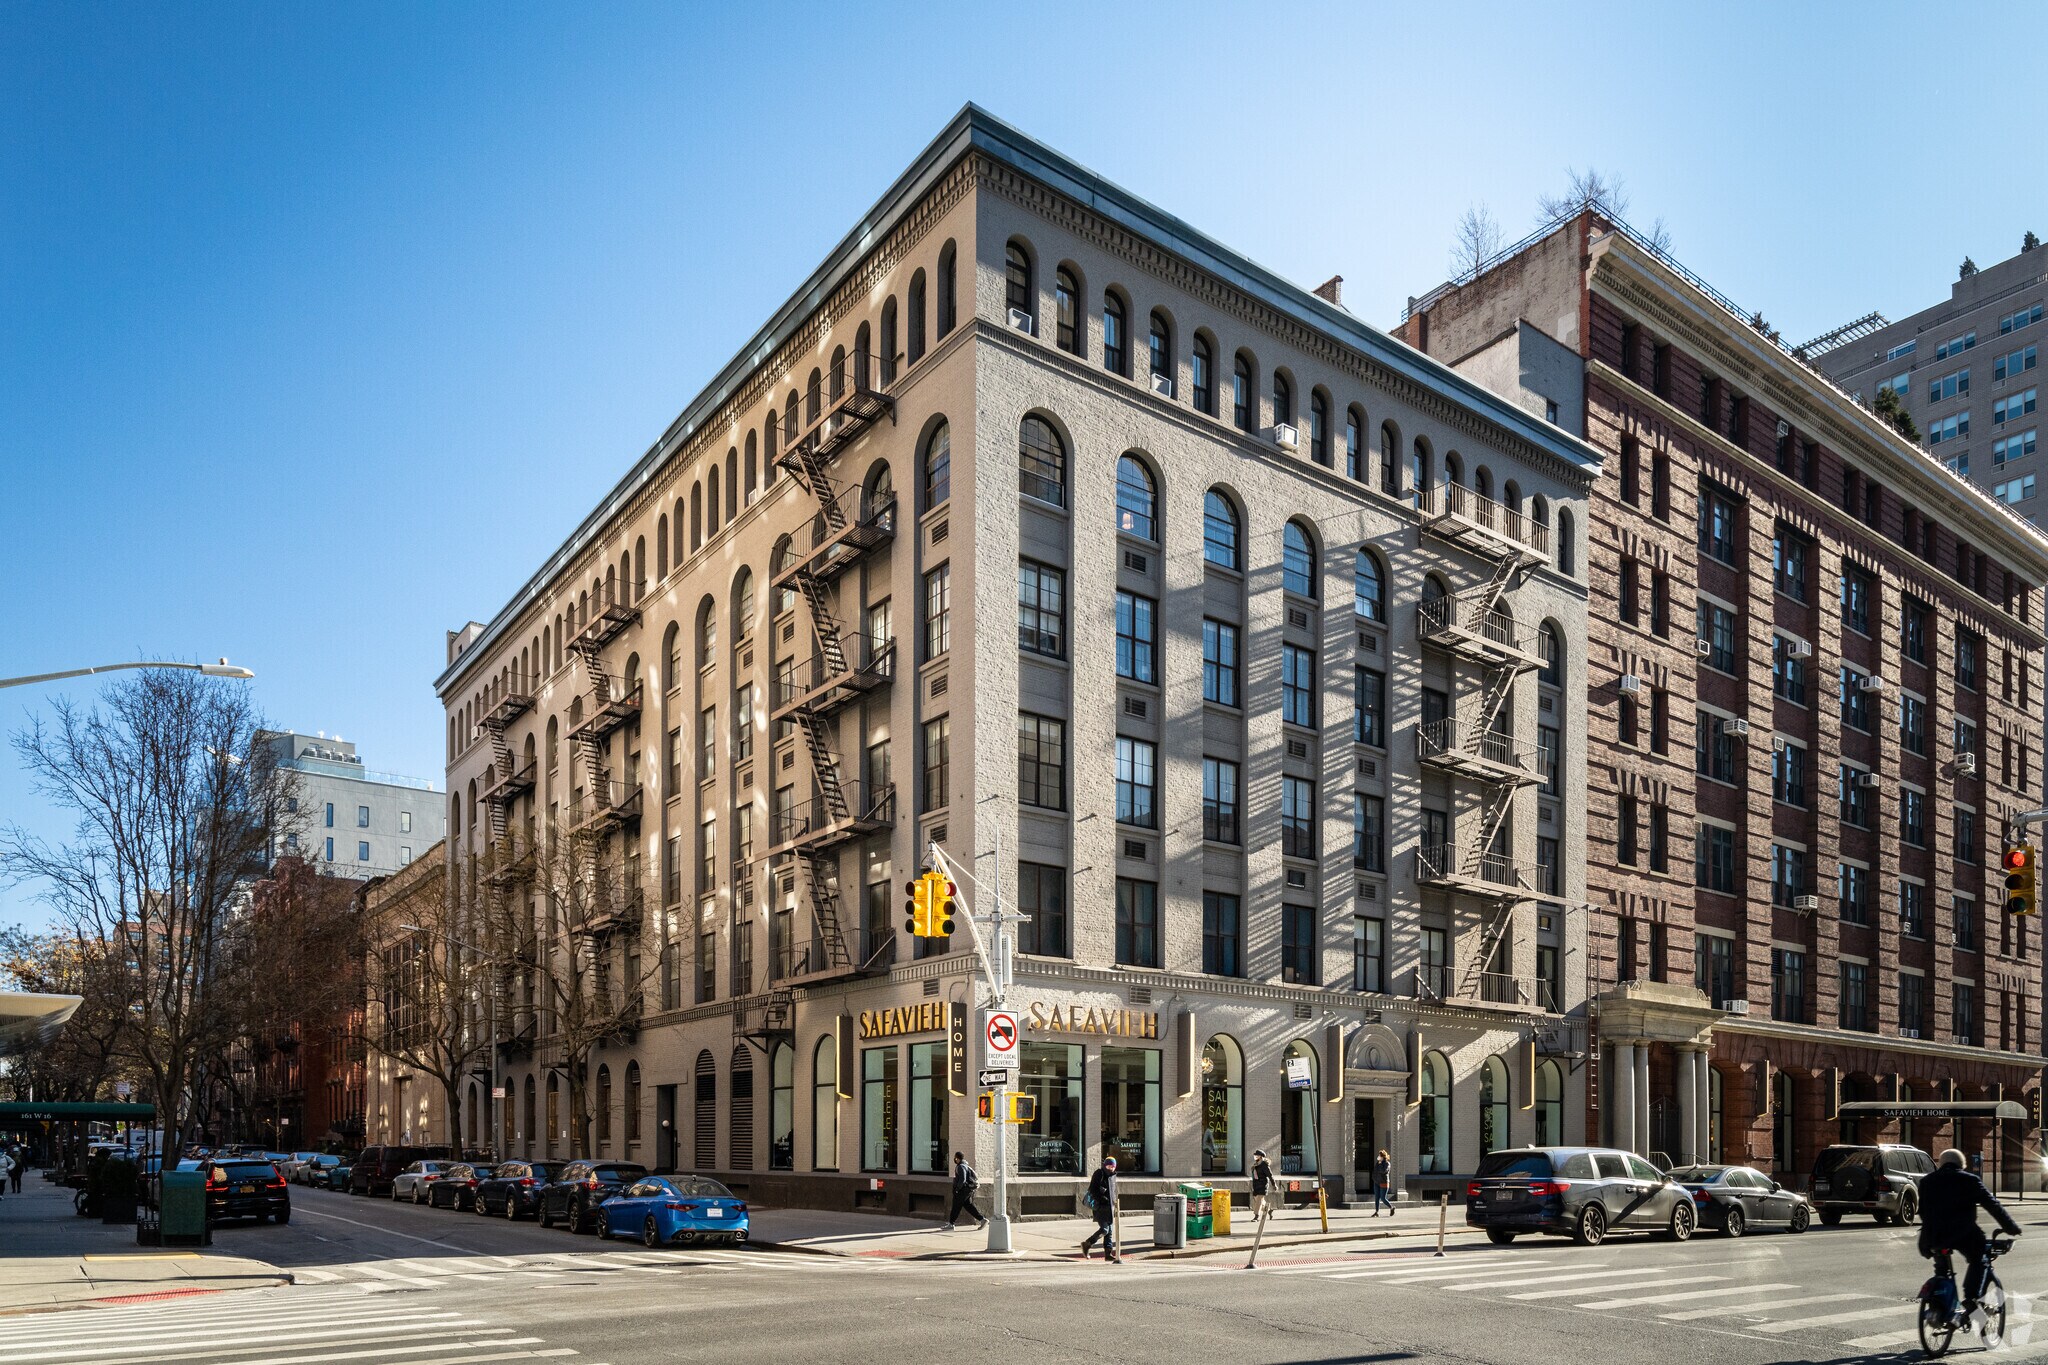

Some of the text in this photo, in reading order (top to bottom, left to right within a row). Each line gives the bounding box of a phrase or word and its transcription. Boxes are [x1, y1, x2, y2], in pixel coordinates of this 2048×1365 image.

[859, 1002, 945, 1039] SAFAVIEH
[1027, 1001, 1159, 1039] SAFAVIEH
[954, 1018, 963, 1072] HOME
